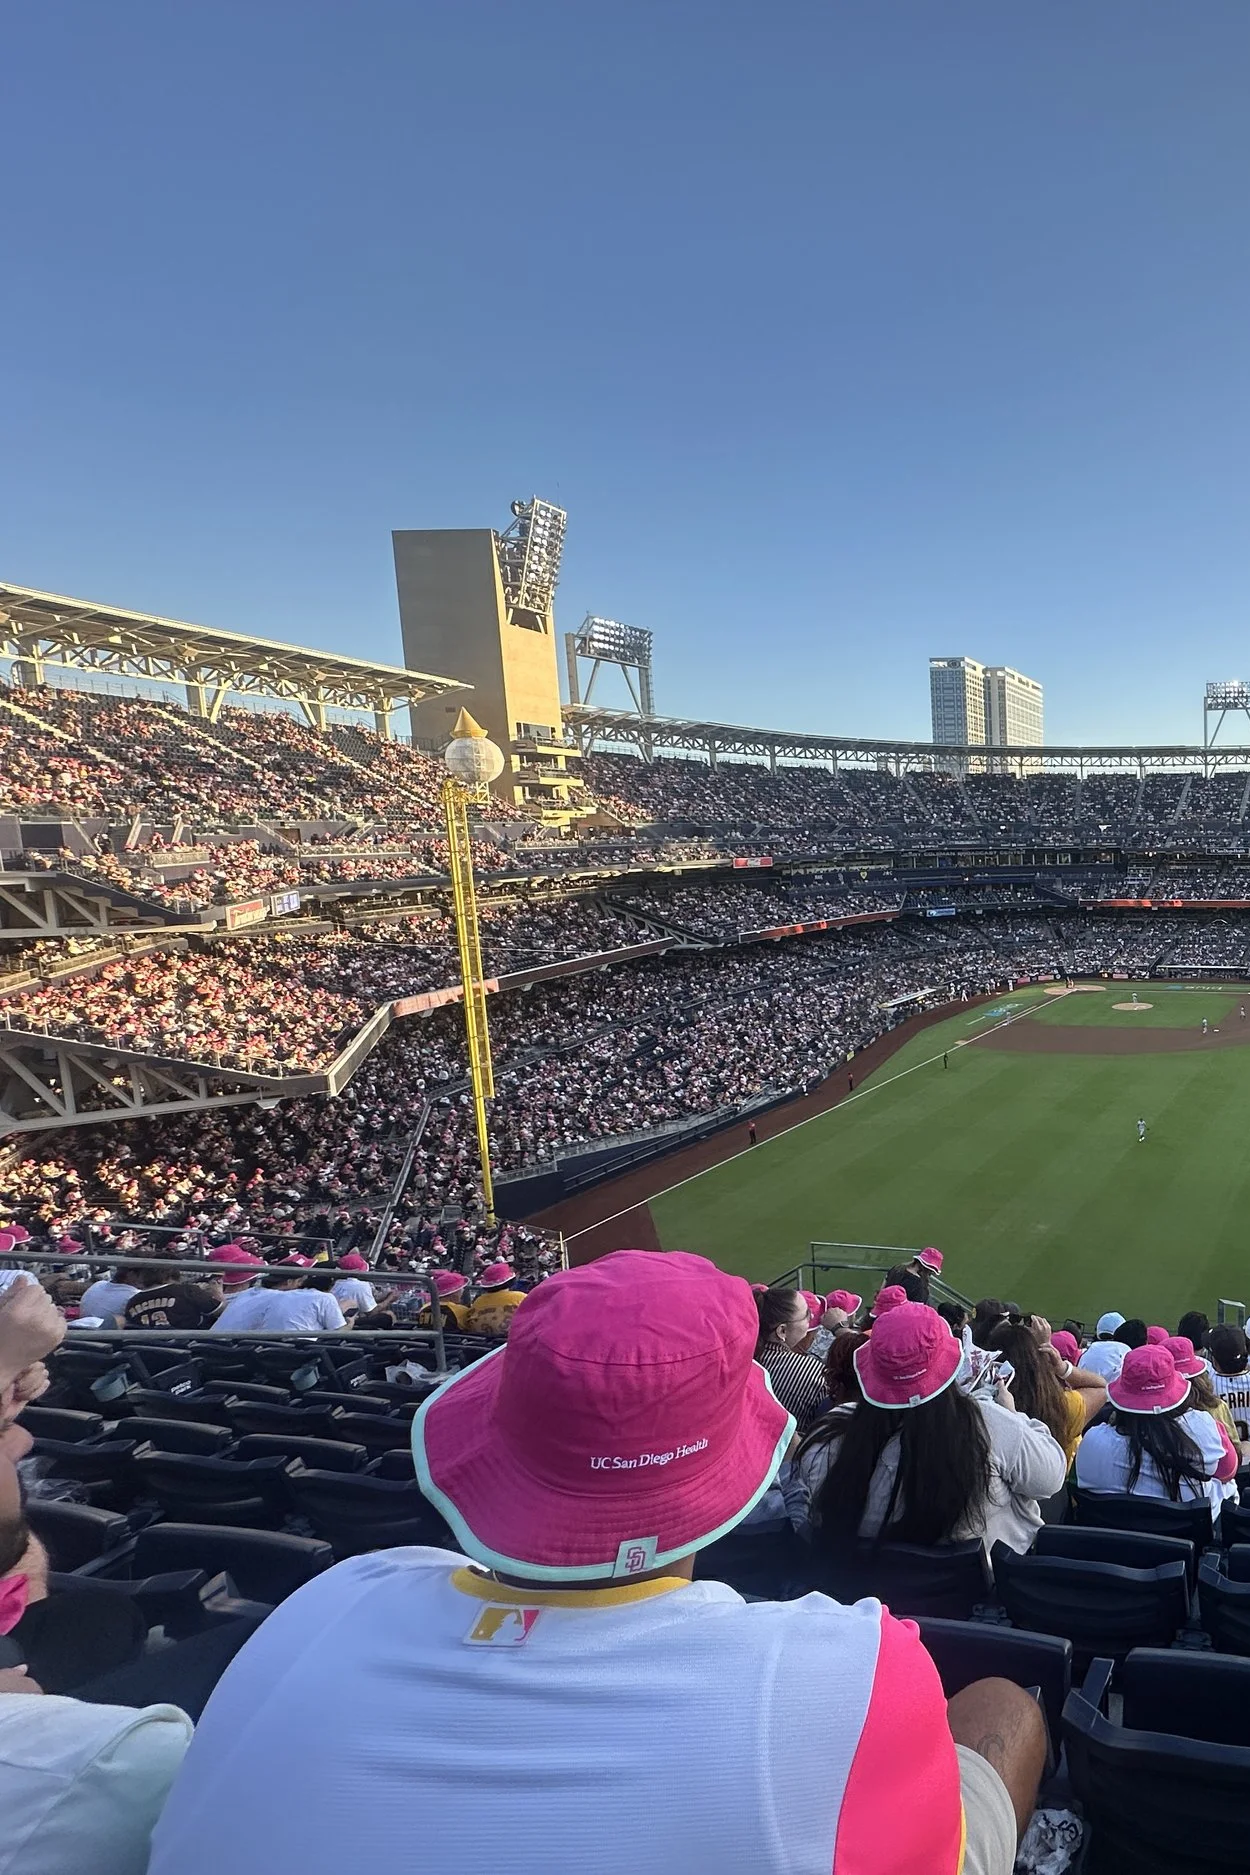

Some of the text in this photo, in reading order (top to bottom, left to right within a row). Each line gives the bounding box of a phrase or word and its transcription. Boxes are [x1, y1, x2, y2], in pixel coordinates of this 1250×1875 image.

[590, 1438, 708, 1470] UC San Diego Health
[625, 1546, 646, 1573] SD
